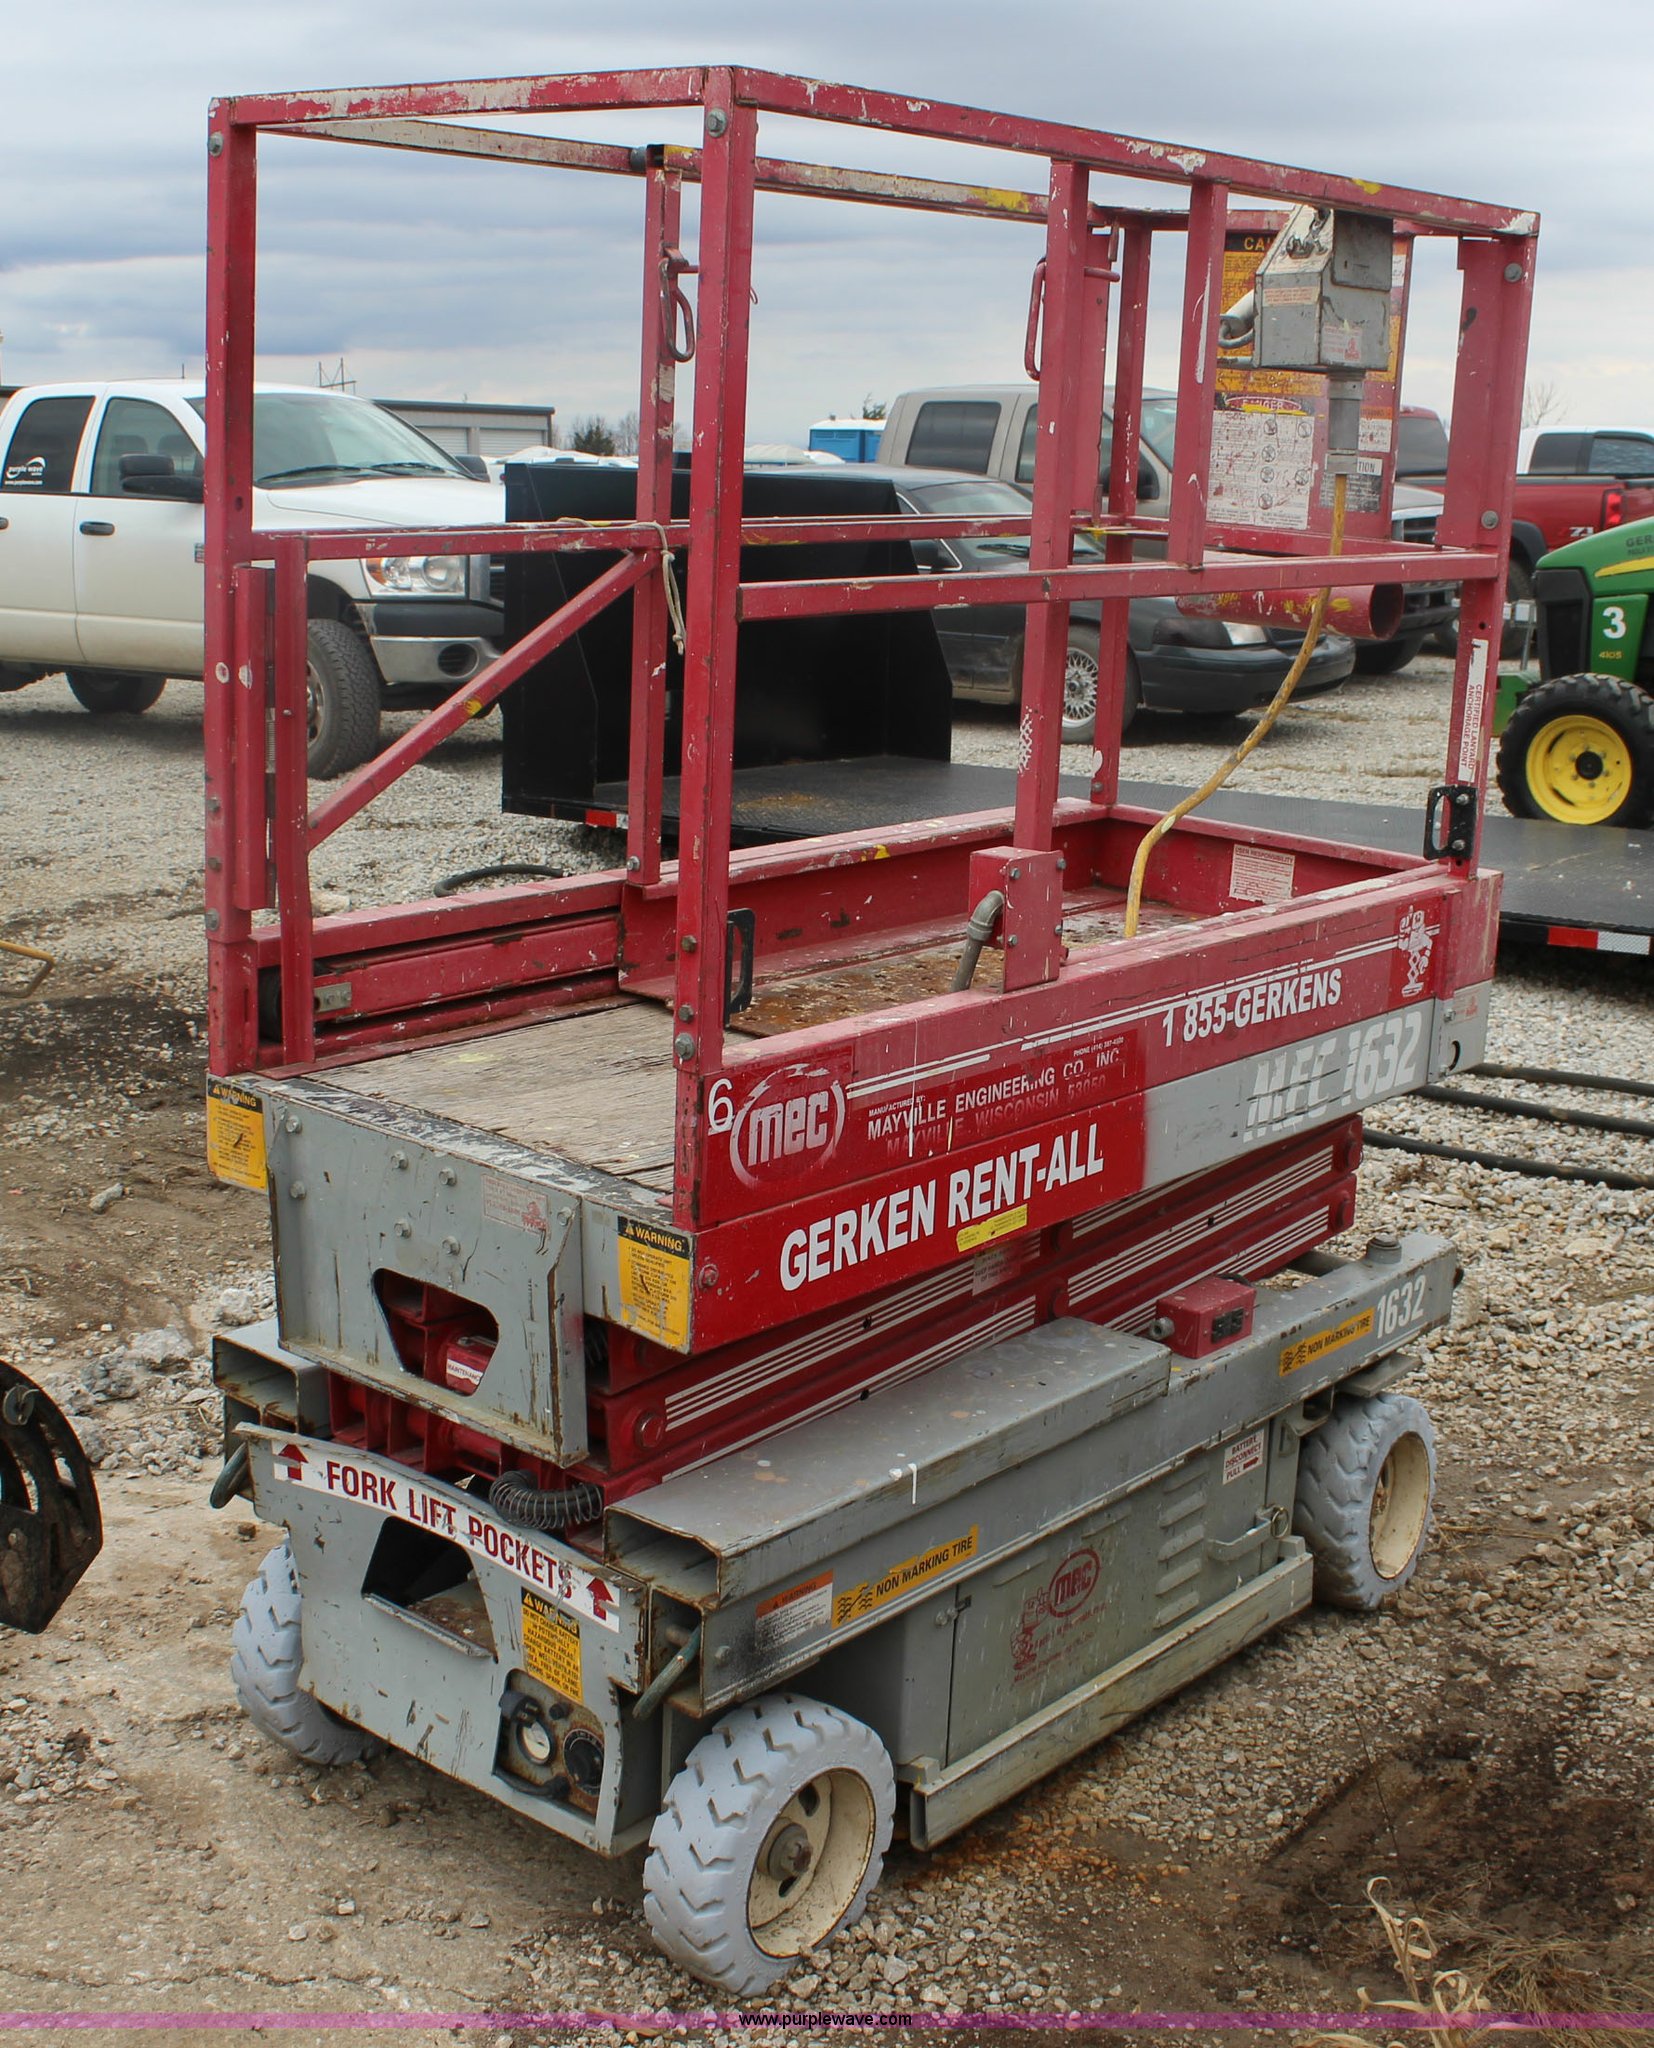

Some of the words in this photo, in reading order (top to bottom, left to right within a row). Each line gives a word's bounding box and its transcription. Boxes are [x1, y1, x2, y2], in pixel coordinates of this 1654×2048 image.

[1602, 606, 1626, 639] 3
[1463, 684, 1475, 740] ANCHORAGE
[1472, 684, 1483, 728] CERTIFIED
[1460, 741, 1470, 768] POINT
[1468, 730, 1478, 770] LANYARD
[1251, 850, 1293, 864] RESPONSIBILITY
[1162, 1007, 1173, 1047] 1
[1182, 967, 1342, 1042] 855-GERKENS
[1341, 1012, 1423, 1106] 1632
[221, 1087, 257, 1107] WARNING
[975, 1087, 1060, 1128] WISCONSIN
[868, 1099, 946, 1140] MAYVILLE
[779, 1180, 937, 1292] GERKEN
[947, 1124, 1104, 1228] RENT-ALL
[635, 1226, 682, 1251] WARNING
[1376, 1275, 1426, 1339] 1632
[1307, 1339, 1323, 1355] NON
[1324, 1324, 1355, 1347] MARKING
[1355, 1315, 1371, 1334] TIRE
[1226, 1442, 1261, 1468] DISCONNECT
[1227, 1466, 1240, 1480] PULL
[326, 1460, 397, 1511] FORK
[409, 1489, 457, 1534] LIFT
[468, 1515, 574, 1600] POCKETS
[875, 1575, 900, 1598] NON
[901, 1554, 948, 1590] MARKING
[949, 1535, 974, 1564] TIRE
